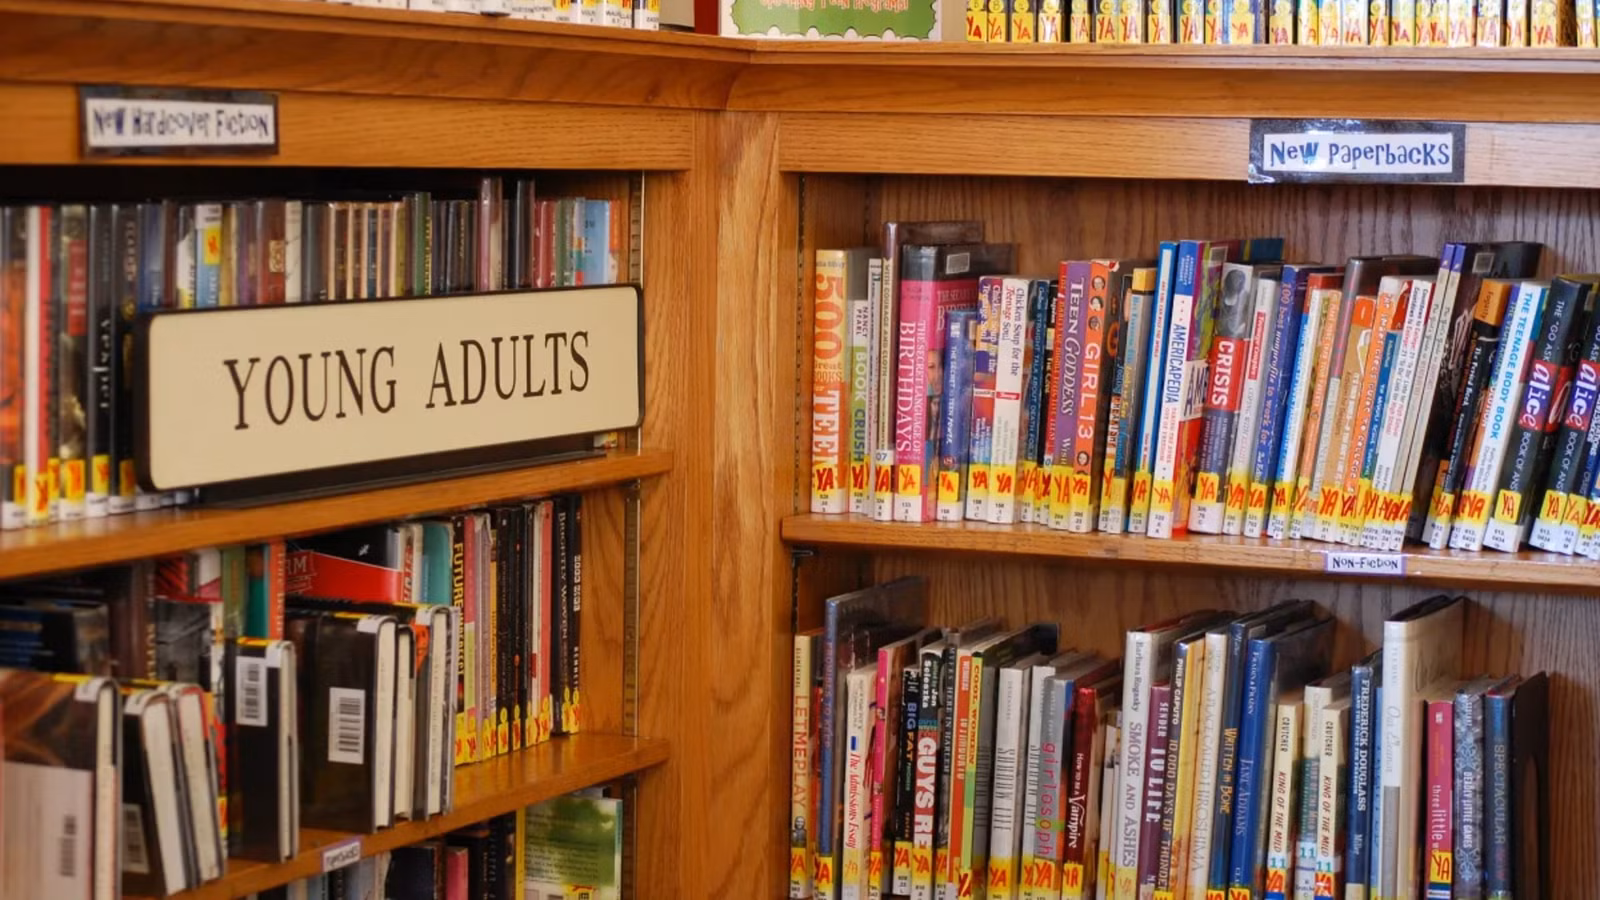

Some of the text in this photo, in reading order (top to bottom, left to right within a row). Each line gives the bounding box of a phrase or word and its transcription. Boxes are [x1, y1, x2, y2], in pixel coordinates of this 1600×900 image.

[131, 107, 210, 136] Hardcover
[814, 273, 843, 359] 500
[1001, 286, 1014, 340] Teenage Soul
[1479, 289, 1494, 318] Fogarty
[1553, 299, 1565, 317] THE
[1010, 287, 1024, 375] Chicken Soup for the
[1059, 276, 1084, 415] TEEN GODDESS
[1165, 322, 1186, 403] AMERICAPEDIA
[1258, 282, 1292, 444] 100 best nonprofits to work for
[1489, 292, 1533, 439] THE TEENAGE BODY BOOK
[1542, 343, 1554, 362] ASK
[223, 331, 590, 430] YOUNG ADULTS
[892, 322, 920, 452] BIRTHDAYS
[911, 320, 925, 452] THE SECRET LANGUAGE OF
[1211, 339, 1234, 405] CRISIS
[1466, 361, 1478, 385] Period
[853, 351, 866, 461] BOOK CRUSH
[1078, 342, 1101, 439] GIRL 13
[1462, 386, 1473, 406] Book
[1517, 431, 1531, 456] BOOK
[1563, 430, 1577, 456] BOOK
[816, 468, 834, 491] YA
[875, 466, 889, 492] YA
[973, 471, 988, 489] YA
[1514, 457, 1524, 470] OF
[1560, 457, 1571, 470] OF
[997, 472, 1012, 493] YA
[1055, 475, 1070, 503] YA
[1200, 477, 1215, 500] YA
[1250, 489, 1264, 507] YA
[1274, 488, 1286, 506] YA
[1321, 488, 1339, 516] YA
[451, 542, 465, 607] FUTURE
[559, 584, 567, 638] WOVEN
[920, 659, 932, 708] Scieszka
[1130, 641, 1144, 711] Barbara Rogasky
[1171, 657, 1184, 724] PHILIP CAPUTO
[941, 647, 955, 771] MYERS HERE IN HARLEM
[967, 664, 981, 764] COOL WOMEN
[1157, 702, 1168, 736] SENDER
[906, 702, 916, 759] BIG FAT
[1278, 716, 1290, 752] CRUTCHER
[1323, 721, 1334, 756] CRUTCHER
[1356, 680, 1370, 811] FREDERICK DOUGLASS
[849, 752, 862, 768] The
[1220, 726, 1236, 770] WRITTEN
[913, 736, 937, 808] GUYS
[847, 771, 862, 820] Admissions
[1121, 720, 1142, 866] SMOKE AND ASHES
[1163, 781, 1174, 814] DAYS
[1218, 784, 1231, 814] BONE
[1234, 757, 1253, 836] JANE ADDAMS
[1431, 784, 1441, 807] three
[1463, 771, 1472, 848] DEADLY LITTLE GAMES
[1493, 744, 1505, 843] SPECTACULAR
[1063, 793, 1086, 847] Vampire
[1162, 818, 1172, 832] OF
[1191, 780, 1212, 872] HIROSHIMA
[1272, 770, 1287, 852] KING OF THE MILD
[1320, 775, 1332, 857] KING OF THE MILD
[1430, 808, 1446, 839] little
[845, 822, 860, 848] Essay
[1352, 833, 1362, 855] Miller
[913, 854, 930, 873] YA
[1270, 859, 1286, 868] 11
[1300, 848, 1316, 858] 11
[1316, 862, 1332, 871] 11
[1432, 854, 1450, 880] YA
[990, 867, 1006, 887] YA
[1035, 862, 1053, 889] YA
